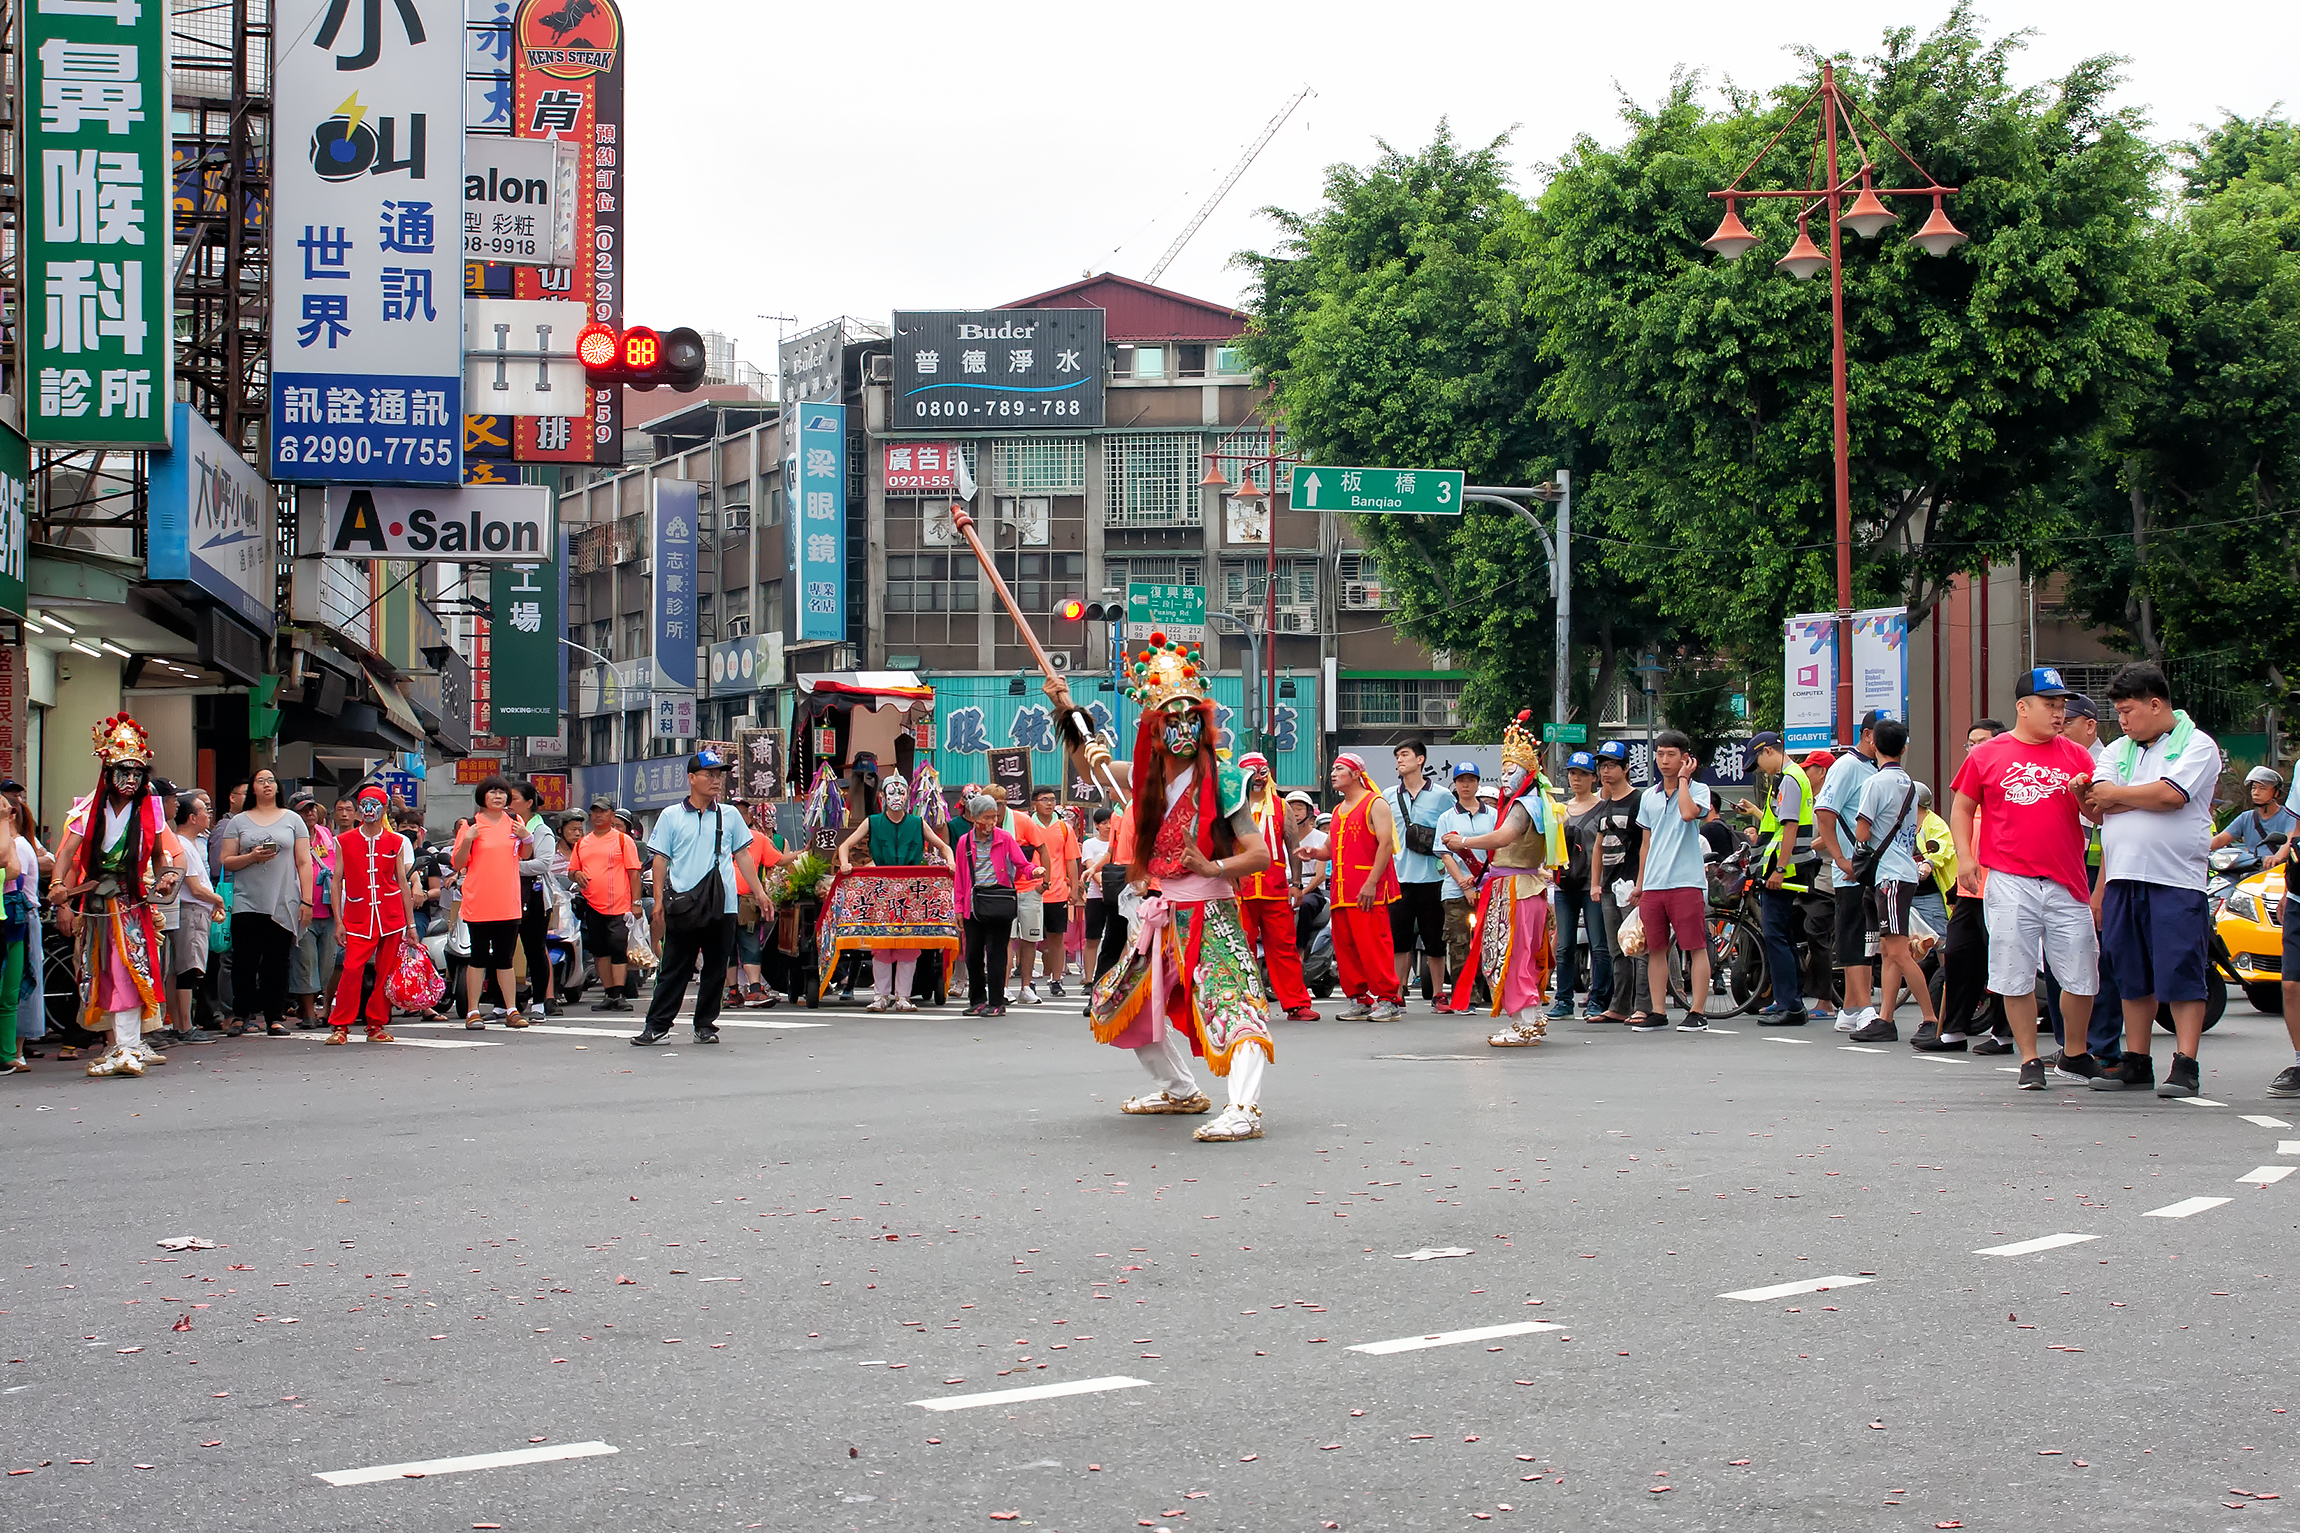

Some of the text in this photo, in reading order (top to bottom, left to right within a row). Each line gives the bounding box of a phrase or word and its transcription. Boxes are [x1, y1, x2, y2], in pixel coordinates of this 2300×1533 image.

[526, 49, 613, 70] KEN'S STEAK
[38, 0, 148, 356] 鼻喉科
[596, 124, 616, 212] 預約訂位
[297, 224, 353, 350] 世界
[957, 320, 1036, 340] Buder
[792, 354, 823, 376] Buder
[915, 349, 1081, 374] 普德淨水
[40, 367, 152, 419] 診所
[283, 385, 450, 427] 訊詮通訊
[916, 400, 1081, 417] 0800-789-788
[303, 435, 453, 467] 2990-7755
[888, 475, 954, 487] 0921-55
[1340, 471, 1416, 495] 板橋
[806, 448, 836, 563] 梁眼鏡
[1351, 481, 1451, 509] Banqiao 3
[666, 551, 684, 639] 志豪診所
[1150, 585, 1195, 600] 復興路
[808, 599, 835, 613] 名店
[1787, 733, 1828, 742] GIGABYTE
